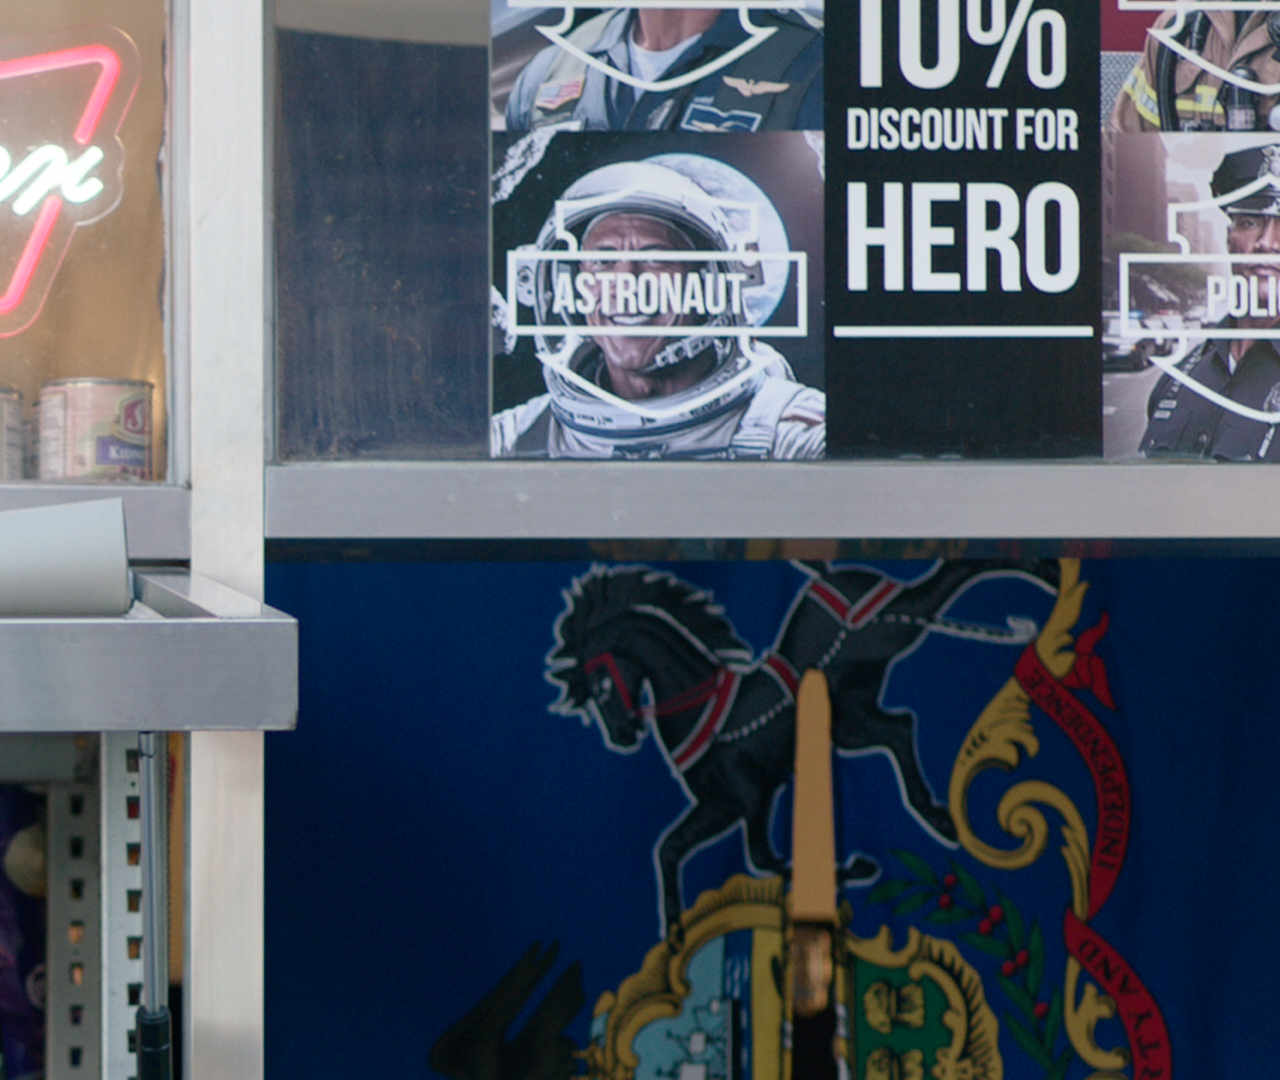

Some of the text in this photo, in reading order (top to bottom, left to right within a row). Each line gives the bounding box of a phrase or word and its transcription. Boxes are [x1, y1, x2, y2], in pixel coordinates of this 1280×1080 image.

[857, 0, 1067, 89] 10%
[847, 107, 1079, 151] DISCOUNT FOR
[847, 181, 1080, 294] HERO
[553, 272, 747, 316] ASTRONAUT
[1207, 275, 1280, 318] POLI
[1078, 939, 1139, 997] AND
